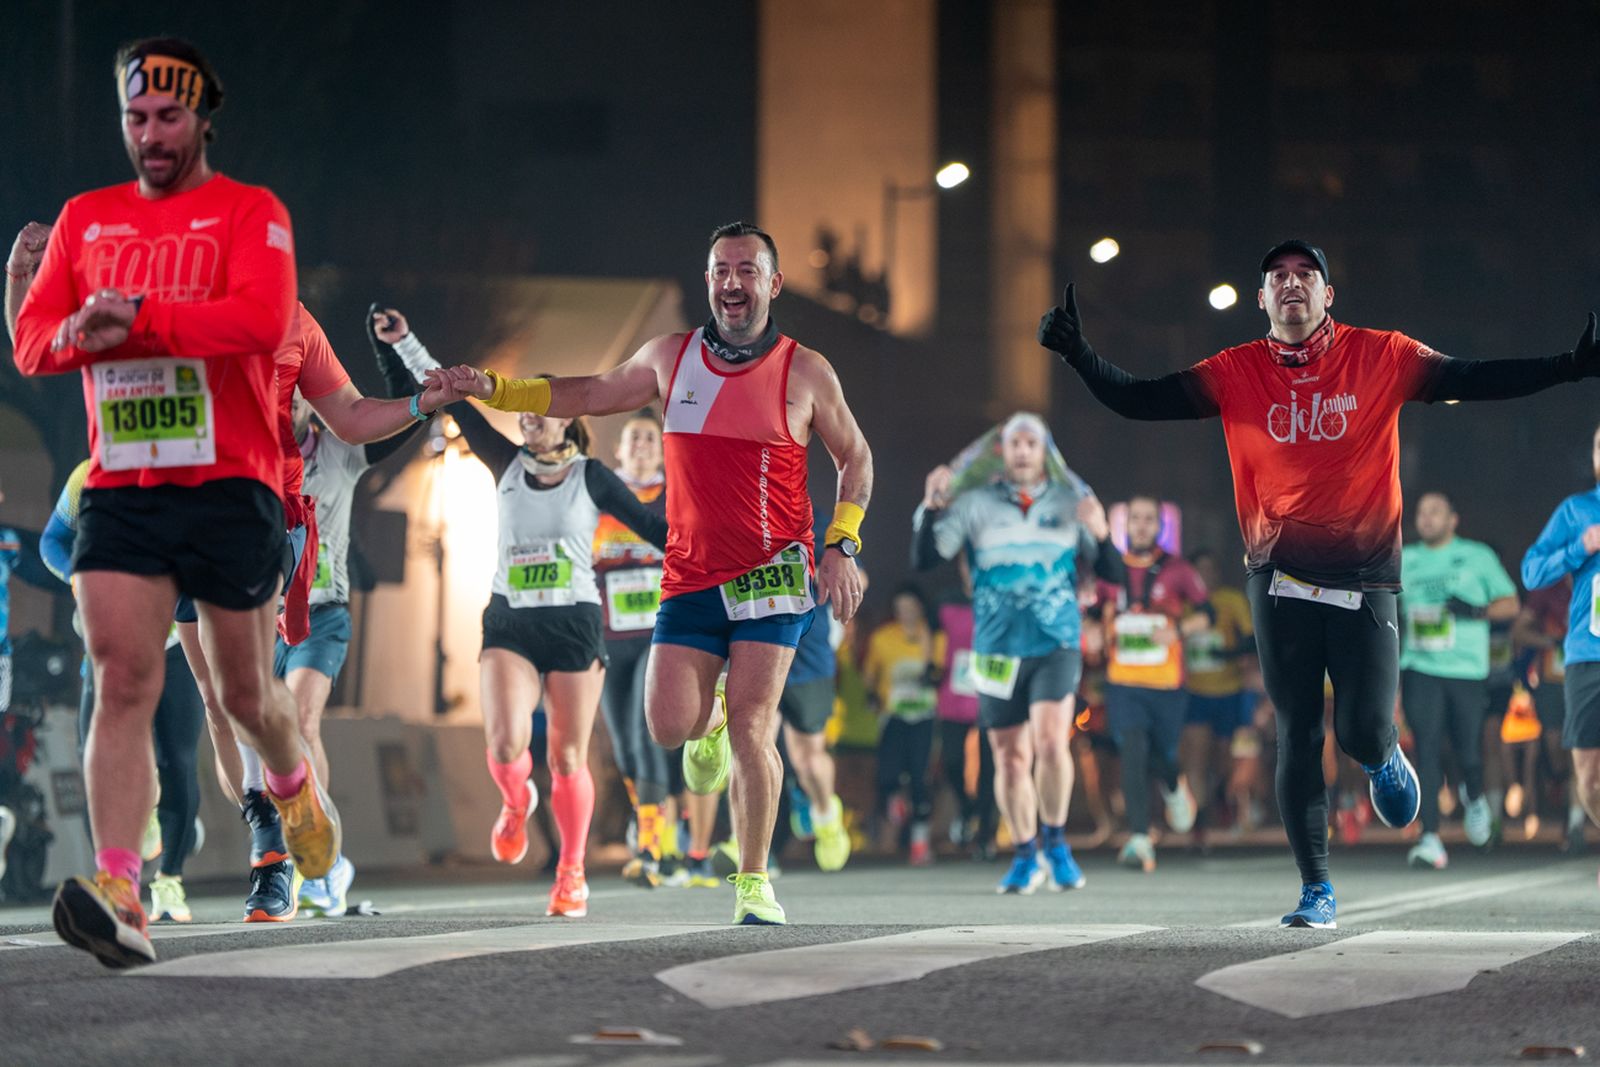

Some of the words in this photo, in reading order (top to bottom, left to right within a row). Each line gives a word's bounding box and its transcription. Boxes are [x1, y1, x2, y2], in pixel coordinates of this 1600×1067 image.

[108, 396, 198, 433] 13095
[761, 448, 770, 473] CLUB
[522, 562, 558, 583] 1773
[736, 564, 794, 593] 9338
